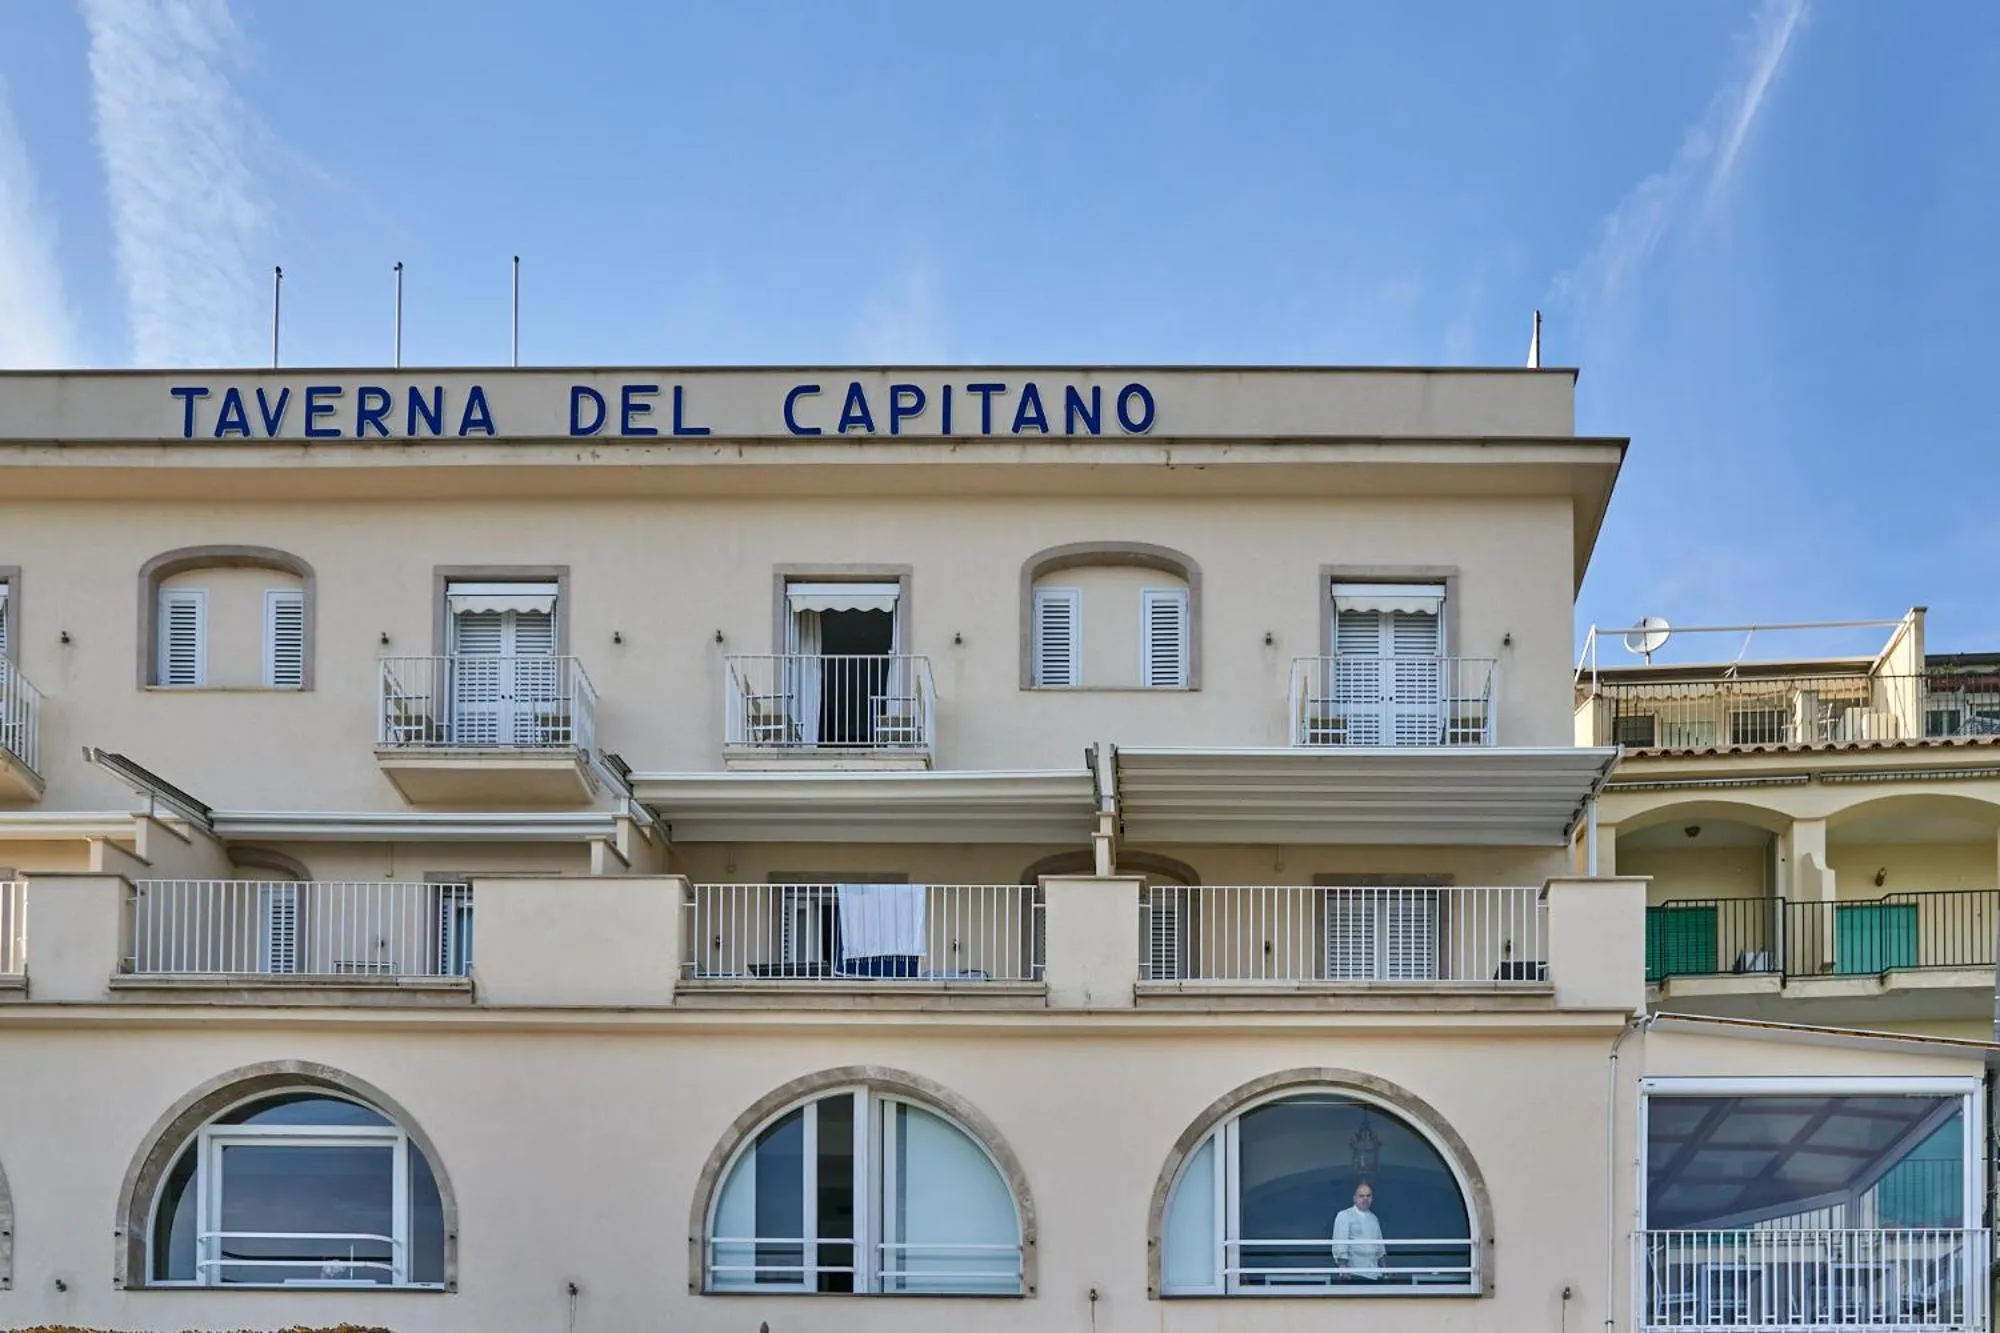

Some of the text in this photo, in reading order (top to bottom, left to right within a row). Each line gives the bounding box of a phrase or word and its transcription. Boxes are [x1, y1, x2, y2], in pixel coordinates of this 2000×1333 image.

[171, 382, 1156, 437] TAVERNA DEL CAPITANO
